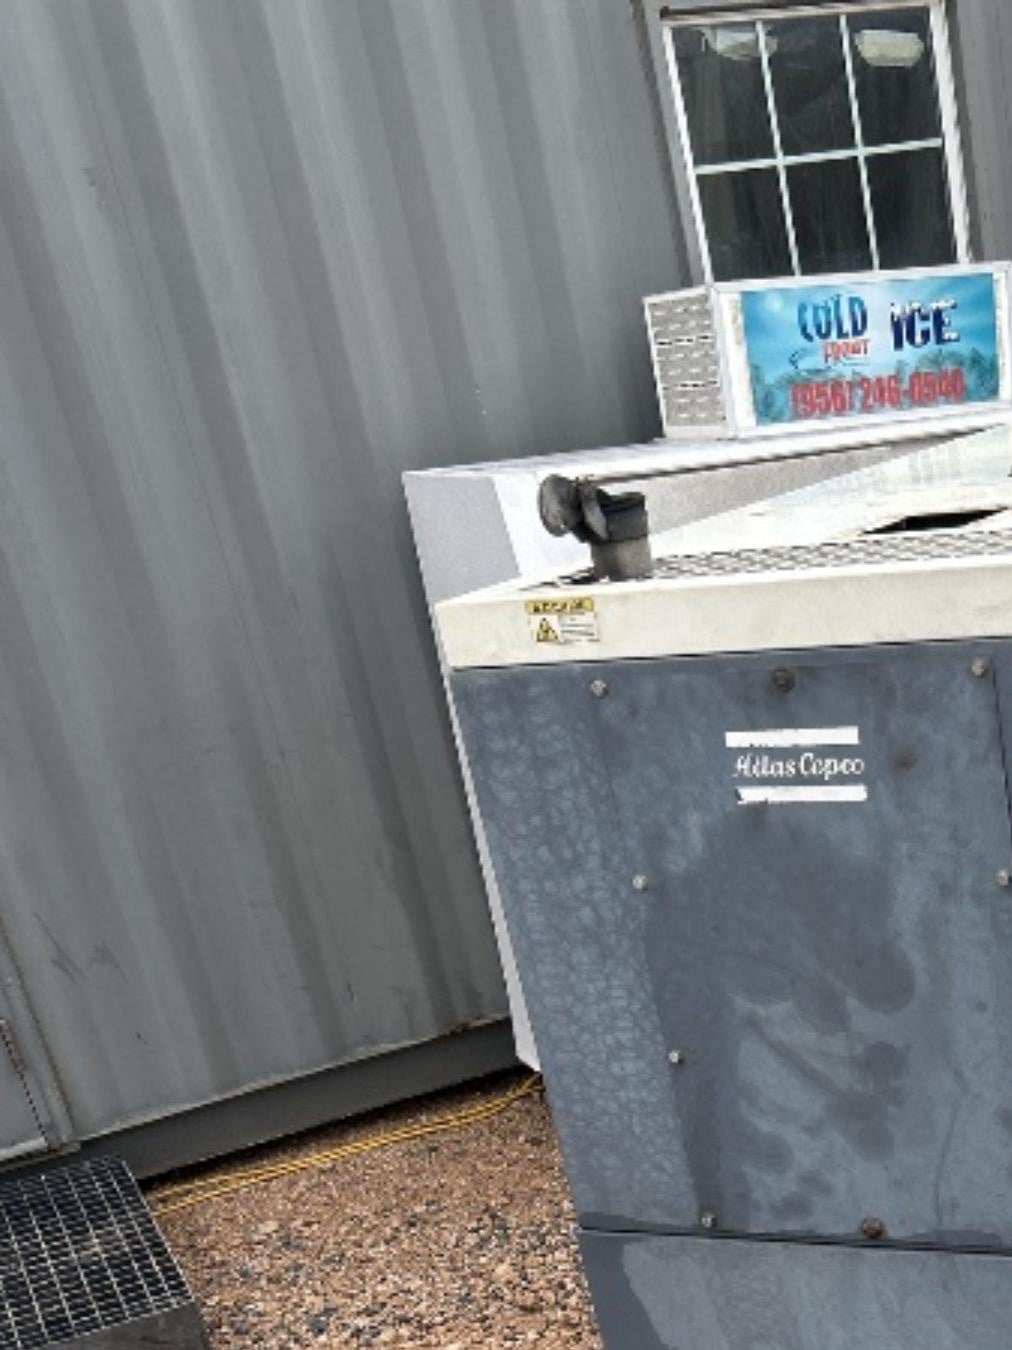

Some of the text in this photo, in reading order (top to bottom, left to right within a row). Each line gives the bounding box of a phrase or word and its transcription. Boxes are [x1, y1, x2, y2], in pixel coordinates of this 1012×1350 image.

[798, 294, 960, 350] COLD ICE
[732, 752, 865, 780] Atlas Copco
